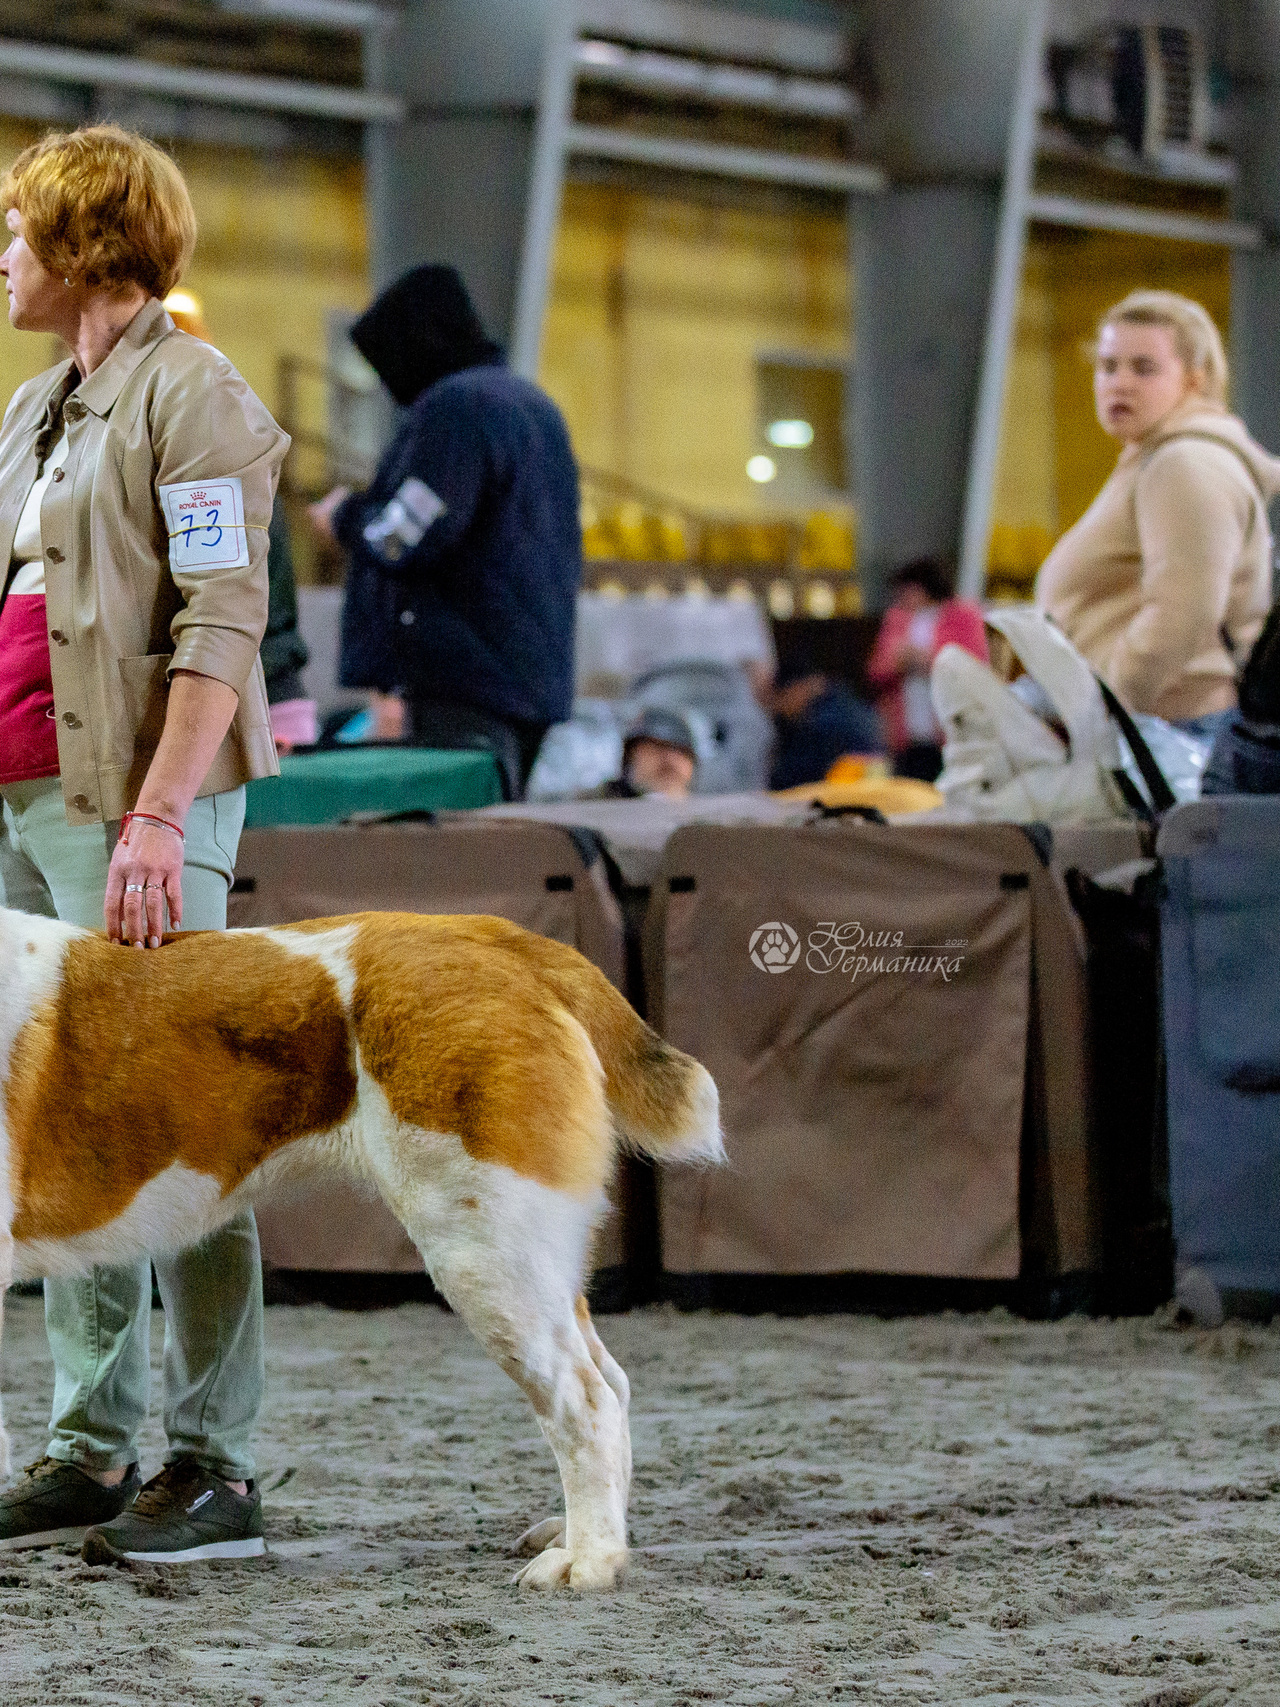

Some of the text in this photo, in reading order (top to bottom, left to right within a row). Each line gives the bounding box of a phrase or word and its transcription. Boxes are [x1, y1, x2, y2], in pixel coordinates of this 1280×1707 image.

[178, 500, 222, 510] ROYAL CANIN
[180, 509, 223, 548] 73
